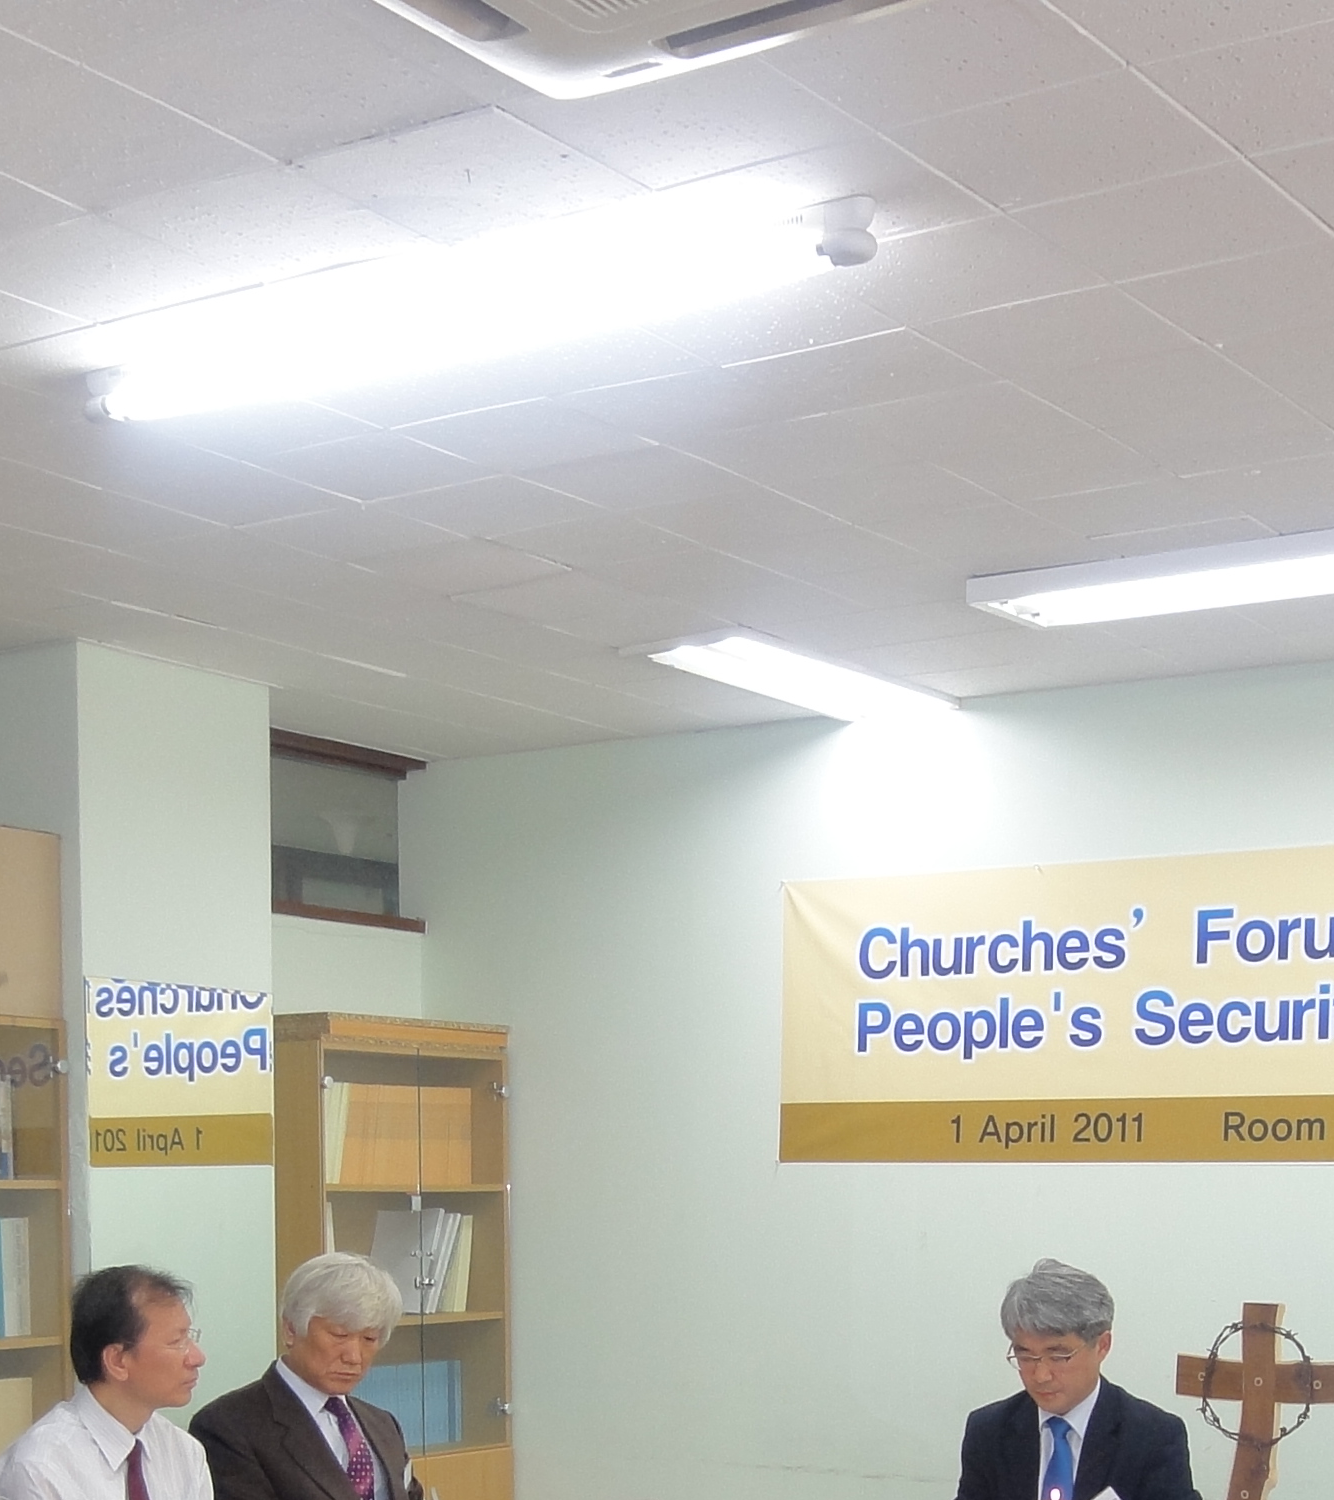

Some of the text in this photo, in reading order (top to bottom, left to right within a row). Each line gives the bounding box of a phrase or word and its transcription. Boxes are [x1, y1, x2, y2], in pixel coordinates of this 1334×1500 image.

[857, 991, 1103, 1061] People's
[950, 1113, 963, 1144] 1
[978, 1113, 1056, 1150] April
[1072, 1112, 1144, 1143] 2011
[1222, 1111, 1326, 1143] Room
